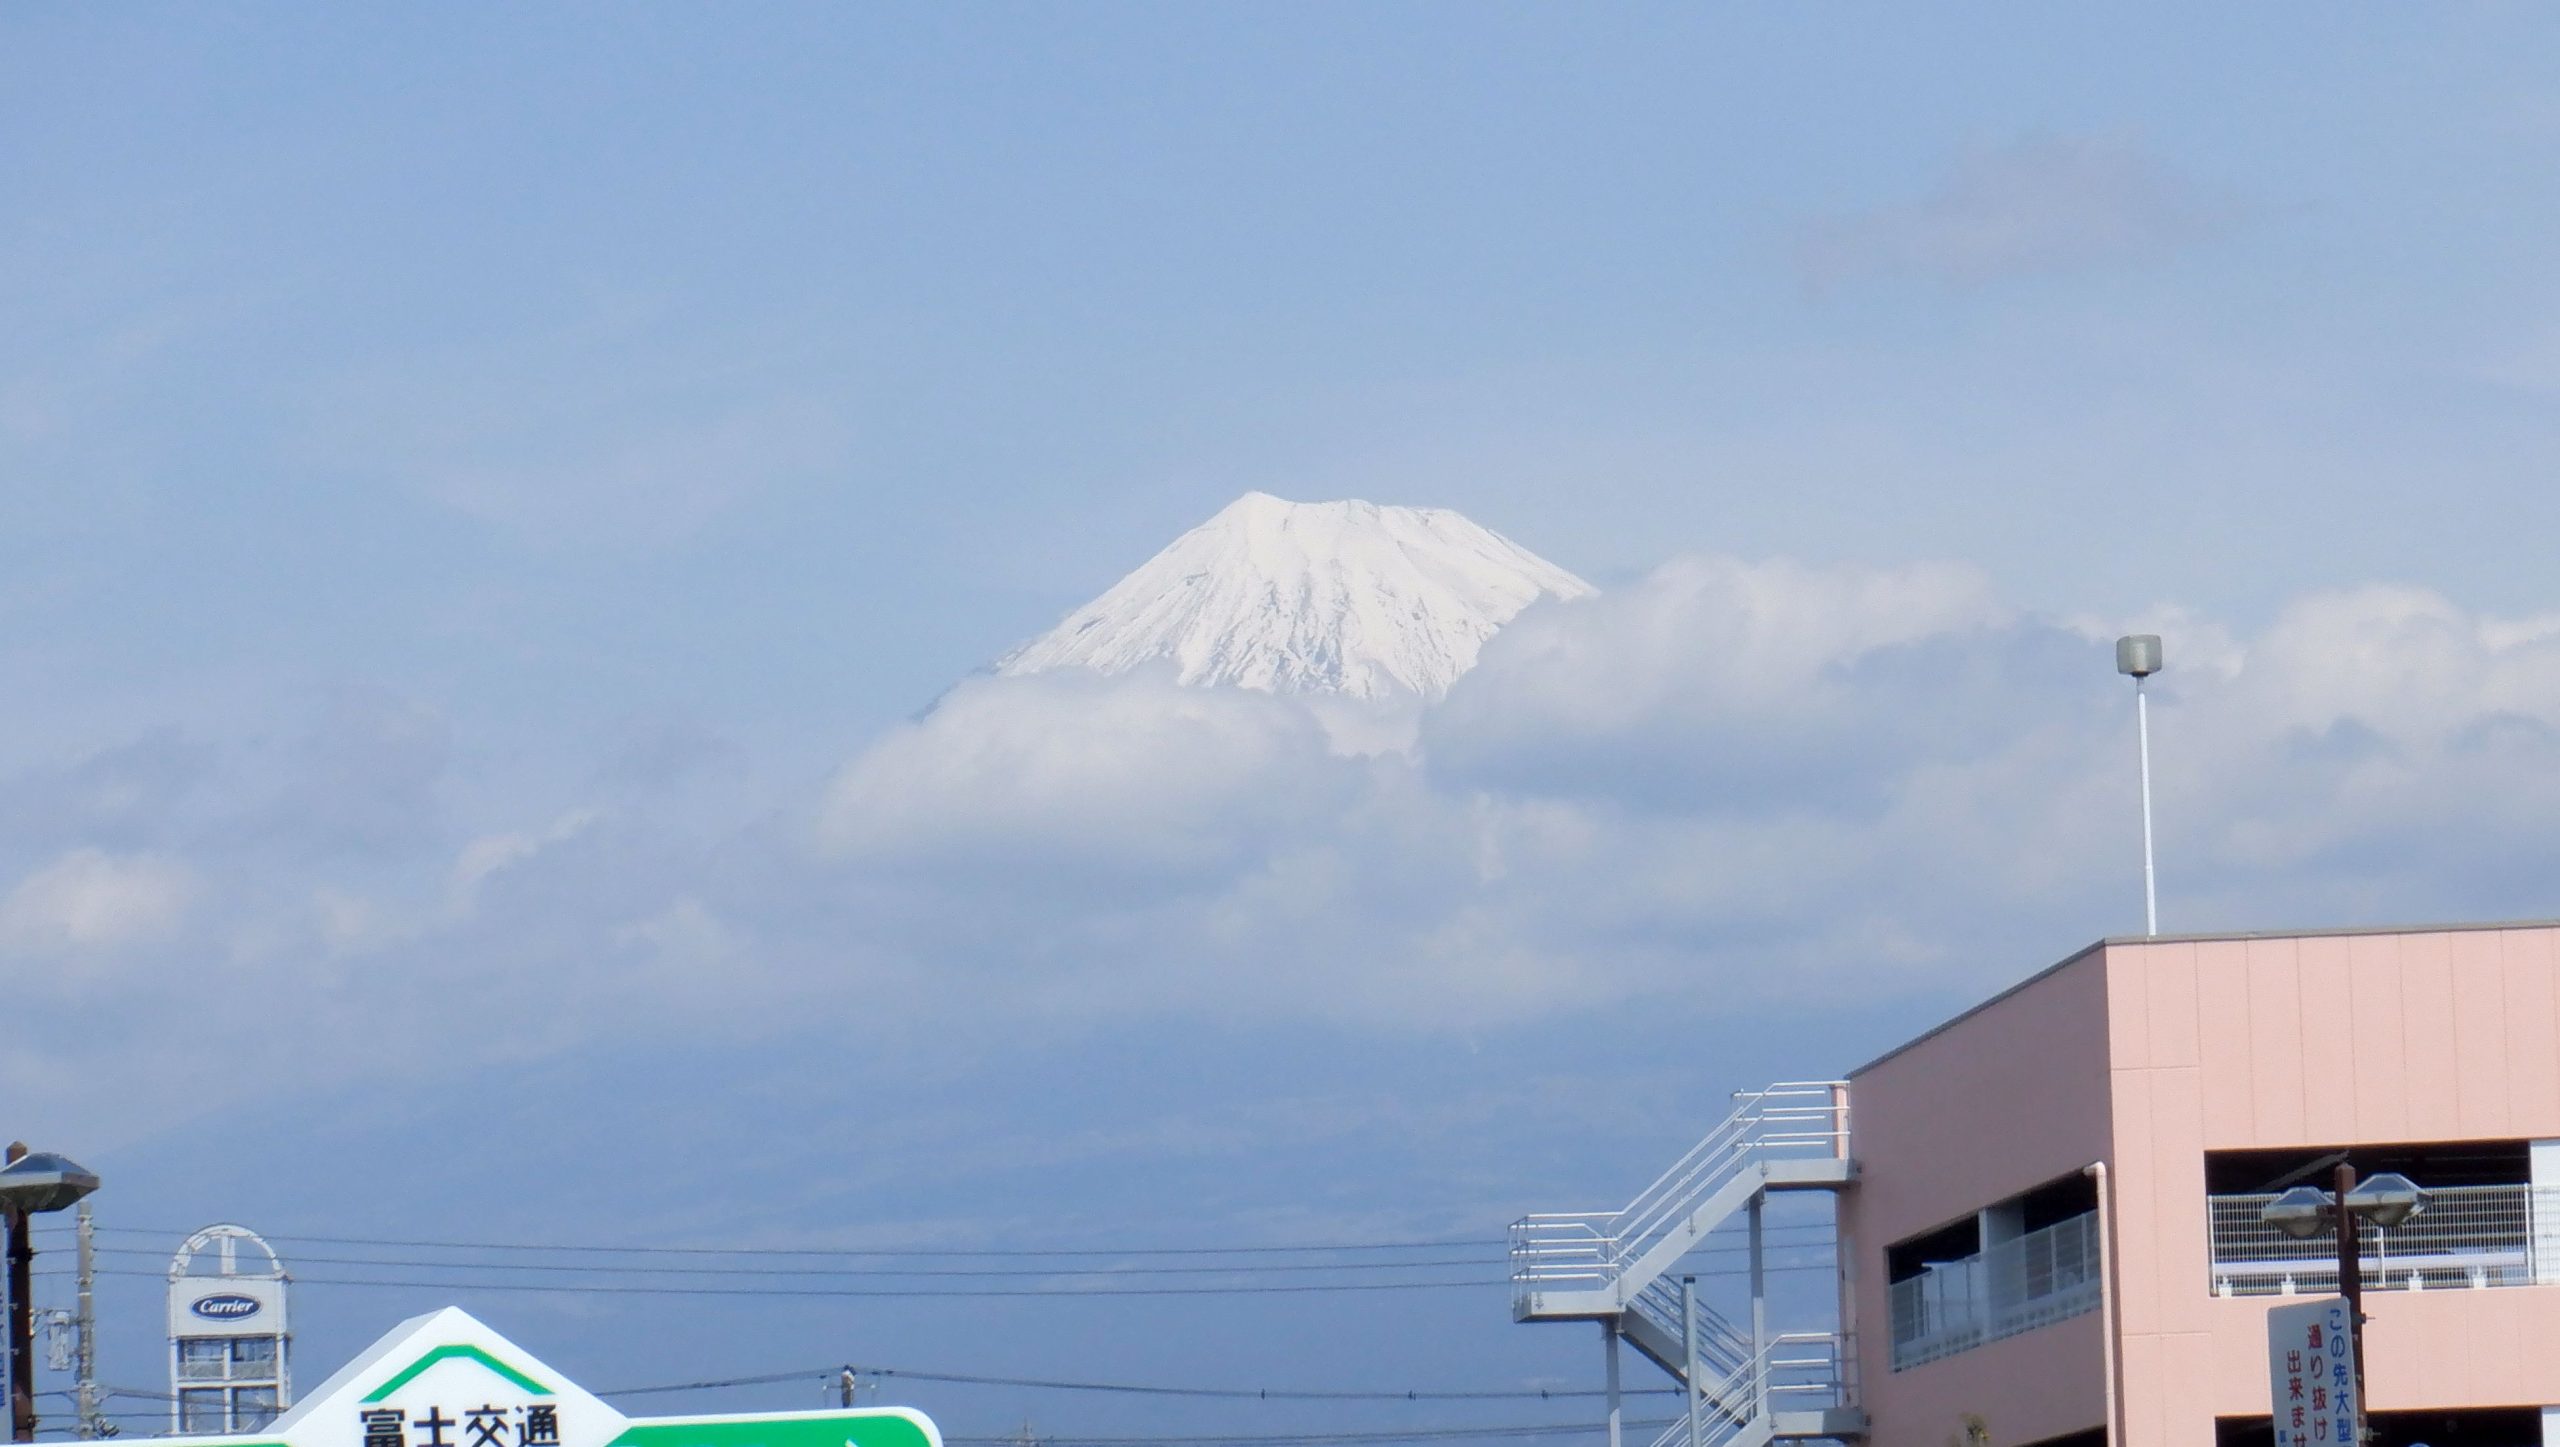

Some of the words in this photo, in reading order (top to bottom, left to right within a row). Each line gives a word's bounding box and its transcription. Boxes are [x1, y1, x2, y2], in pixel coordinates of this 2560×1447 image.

[199, 1299, 254, 1314] Carrier
[2307, 1324, 2328, 1441] 通り抜け
[2329, 1308, 2352, 1447] この先大型
[360, 1403, 561, 1447] 富士交通
